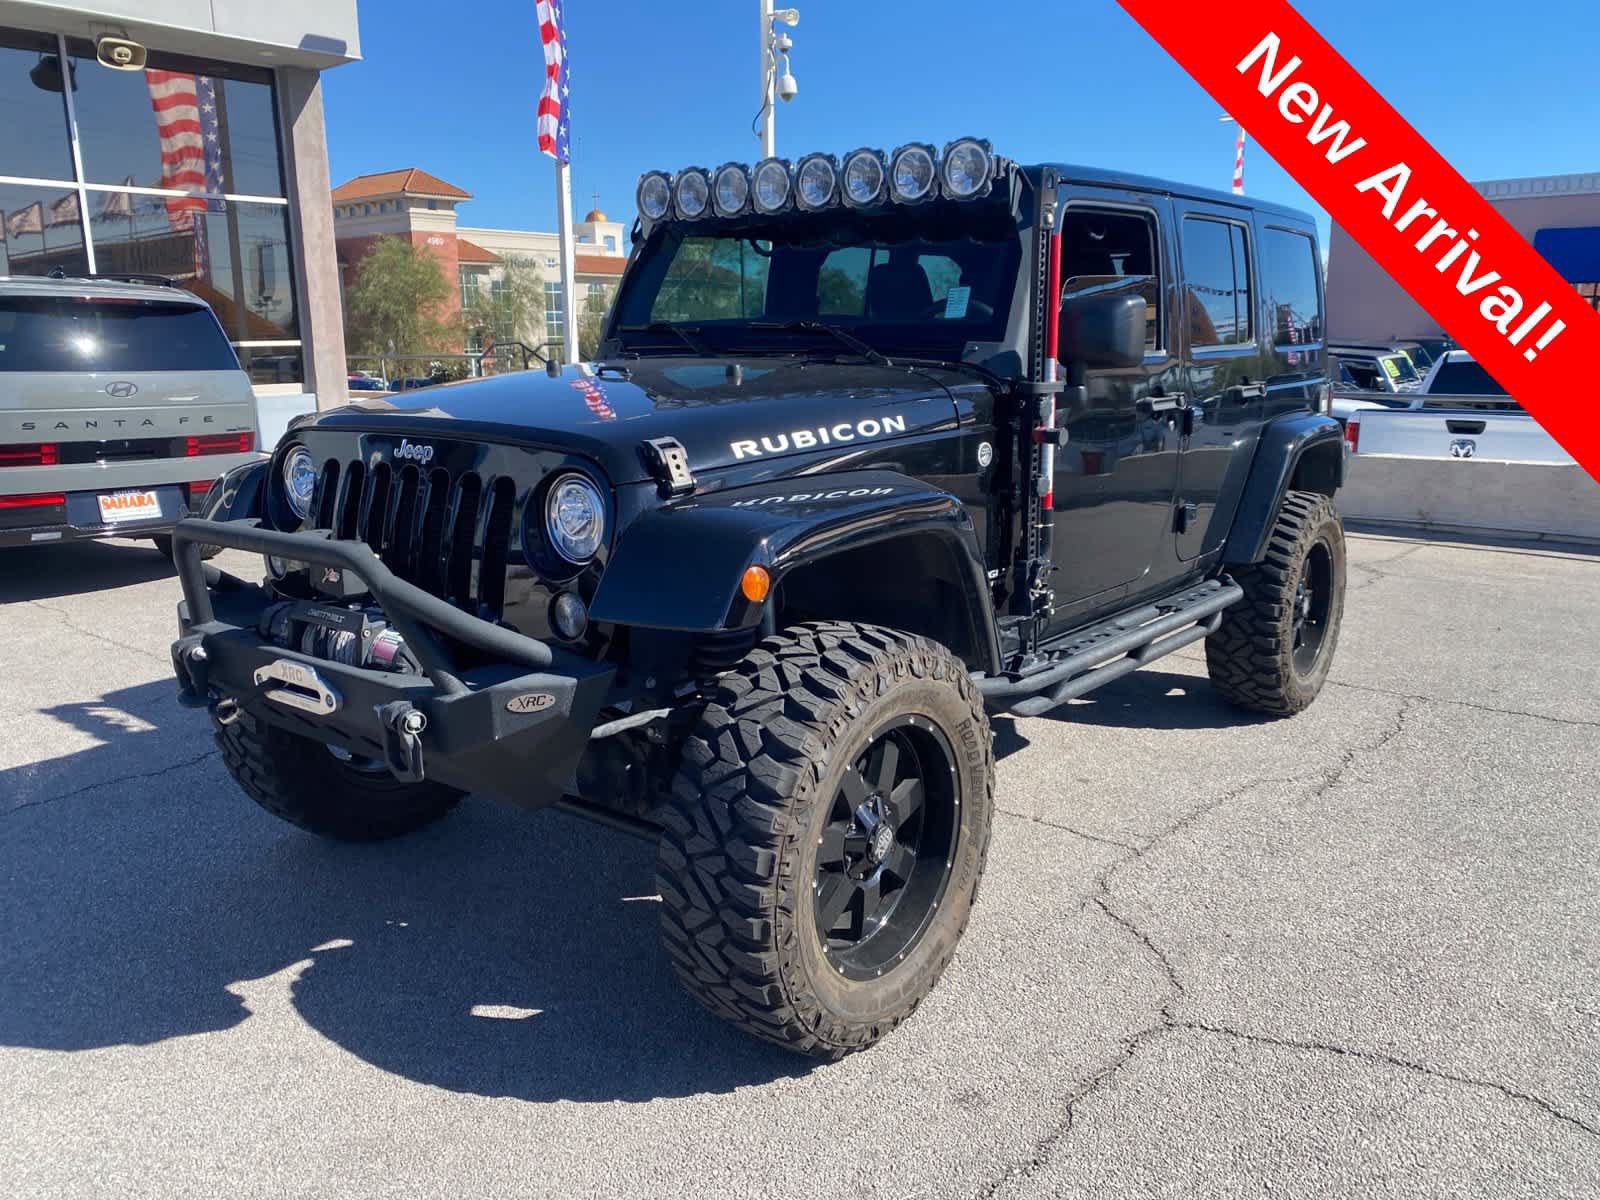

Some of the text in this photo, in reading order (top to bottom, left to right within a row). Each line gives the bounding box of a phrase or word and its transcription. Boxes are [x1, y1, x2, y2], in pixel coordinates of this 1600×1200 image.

[21, 415, 215, 431] SANTA FE
[730, 415, 906, 459] RUBICON
[393, 438, 434, 465] Jeep
[101, 494, 155, 510] SAHARA
[280, 663, 304, 682] XRC
[516, 695, 547, 710] XRC
